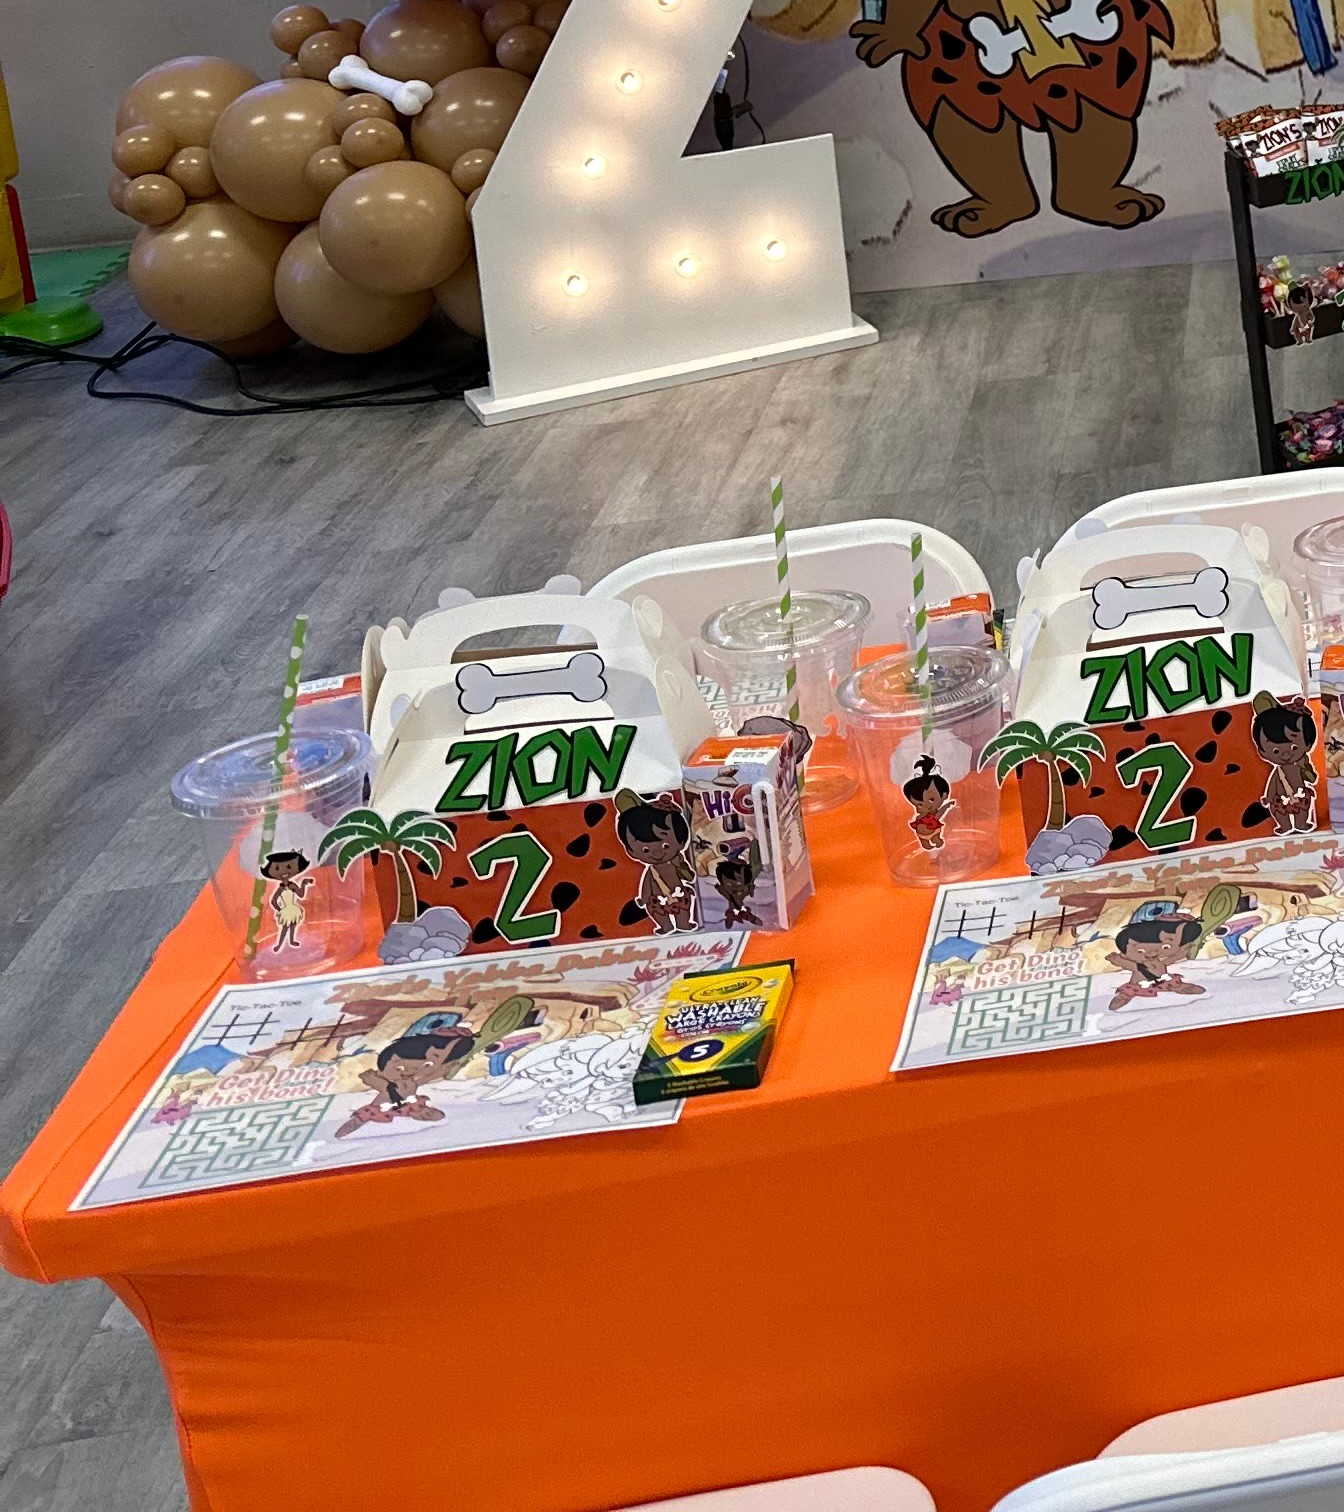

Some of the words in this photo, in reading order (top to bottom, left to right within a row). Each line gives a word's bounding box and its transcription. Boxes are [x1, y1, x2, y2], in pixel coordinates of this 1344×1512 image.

[1260, 123, 1302, 152] ZION'S
[1080, 632, 1254, 725] ZION
[435, 724, 637, 812] ZION
[1115, 741, 1197, 851] 2
[467, 831, 562, 945] 2
[974, 972, 1014, 991] his
[1018, 958, 1084, 986] bone!
[976, 957, 1017, 977] Get
[1028, 948, 1082, 969] Dino
[666, 1002, 766, 1024] WASHABLE
[690, 1044, 710, 1059] 5
[206, 1090, 249, 1106] his
[260, 1077, 330, 1100] bone!
[218, 1075, 266, 1090] Get
[274, 1065, 335, 1084] Dino
